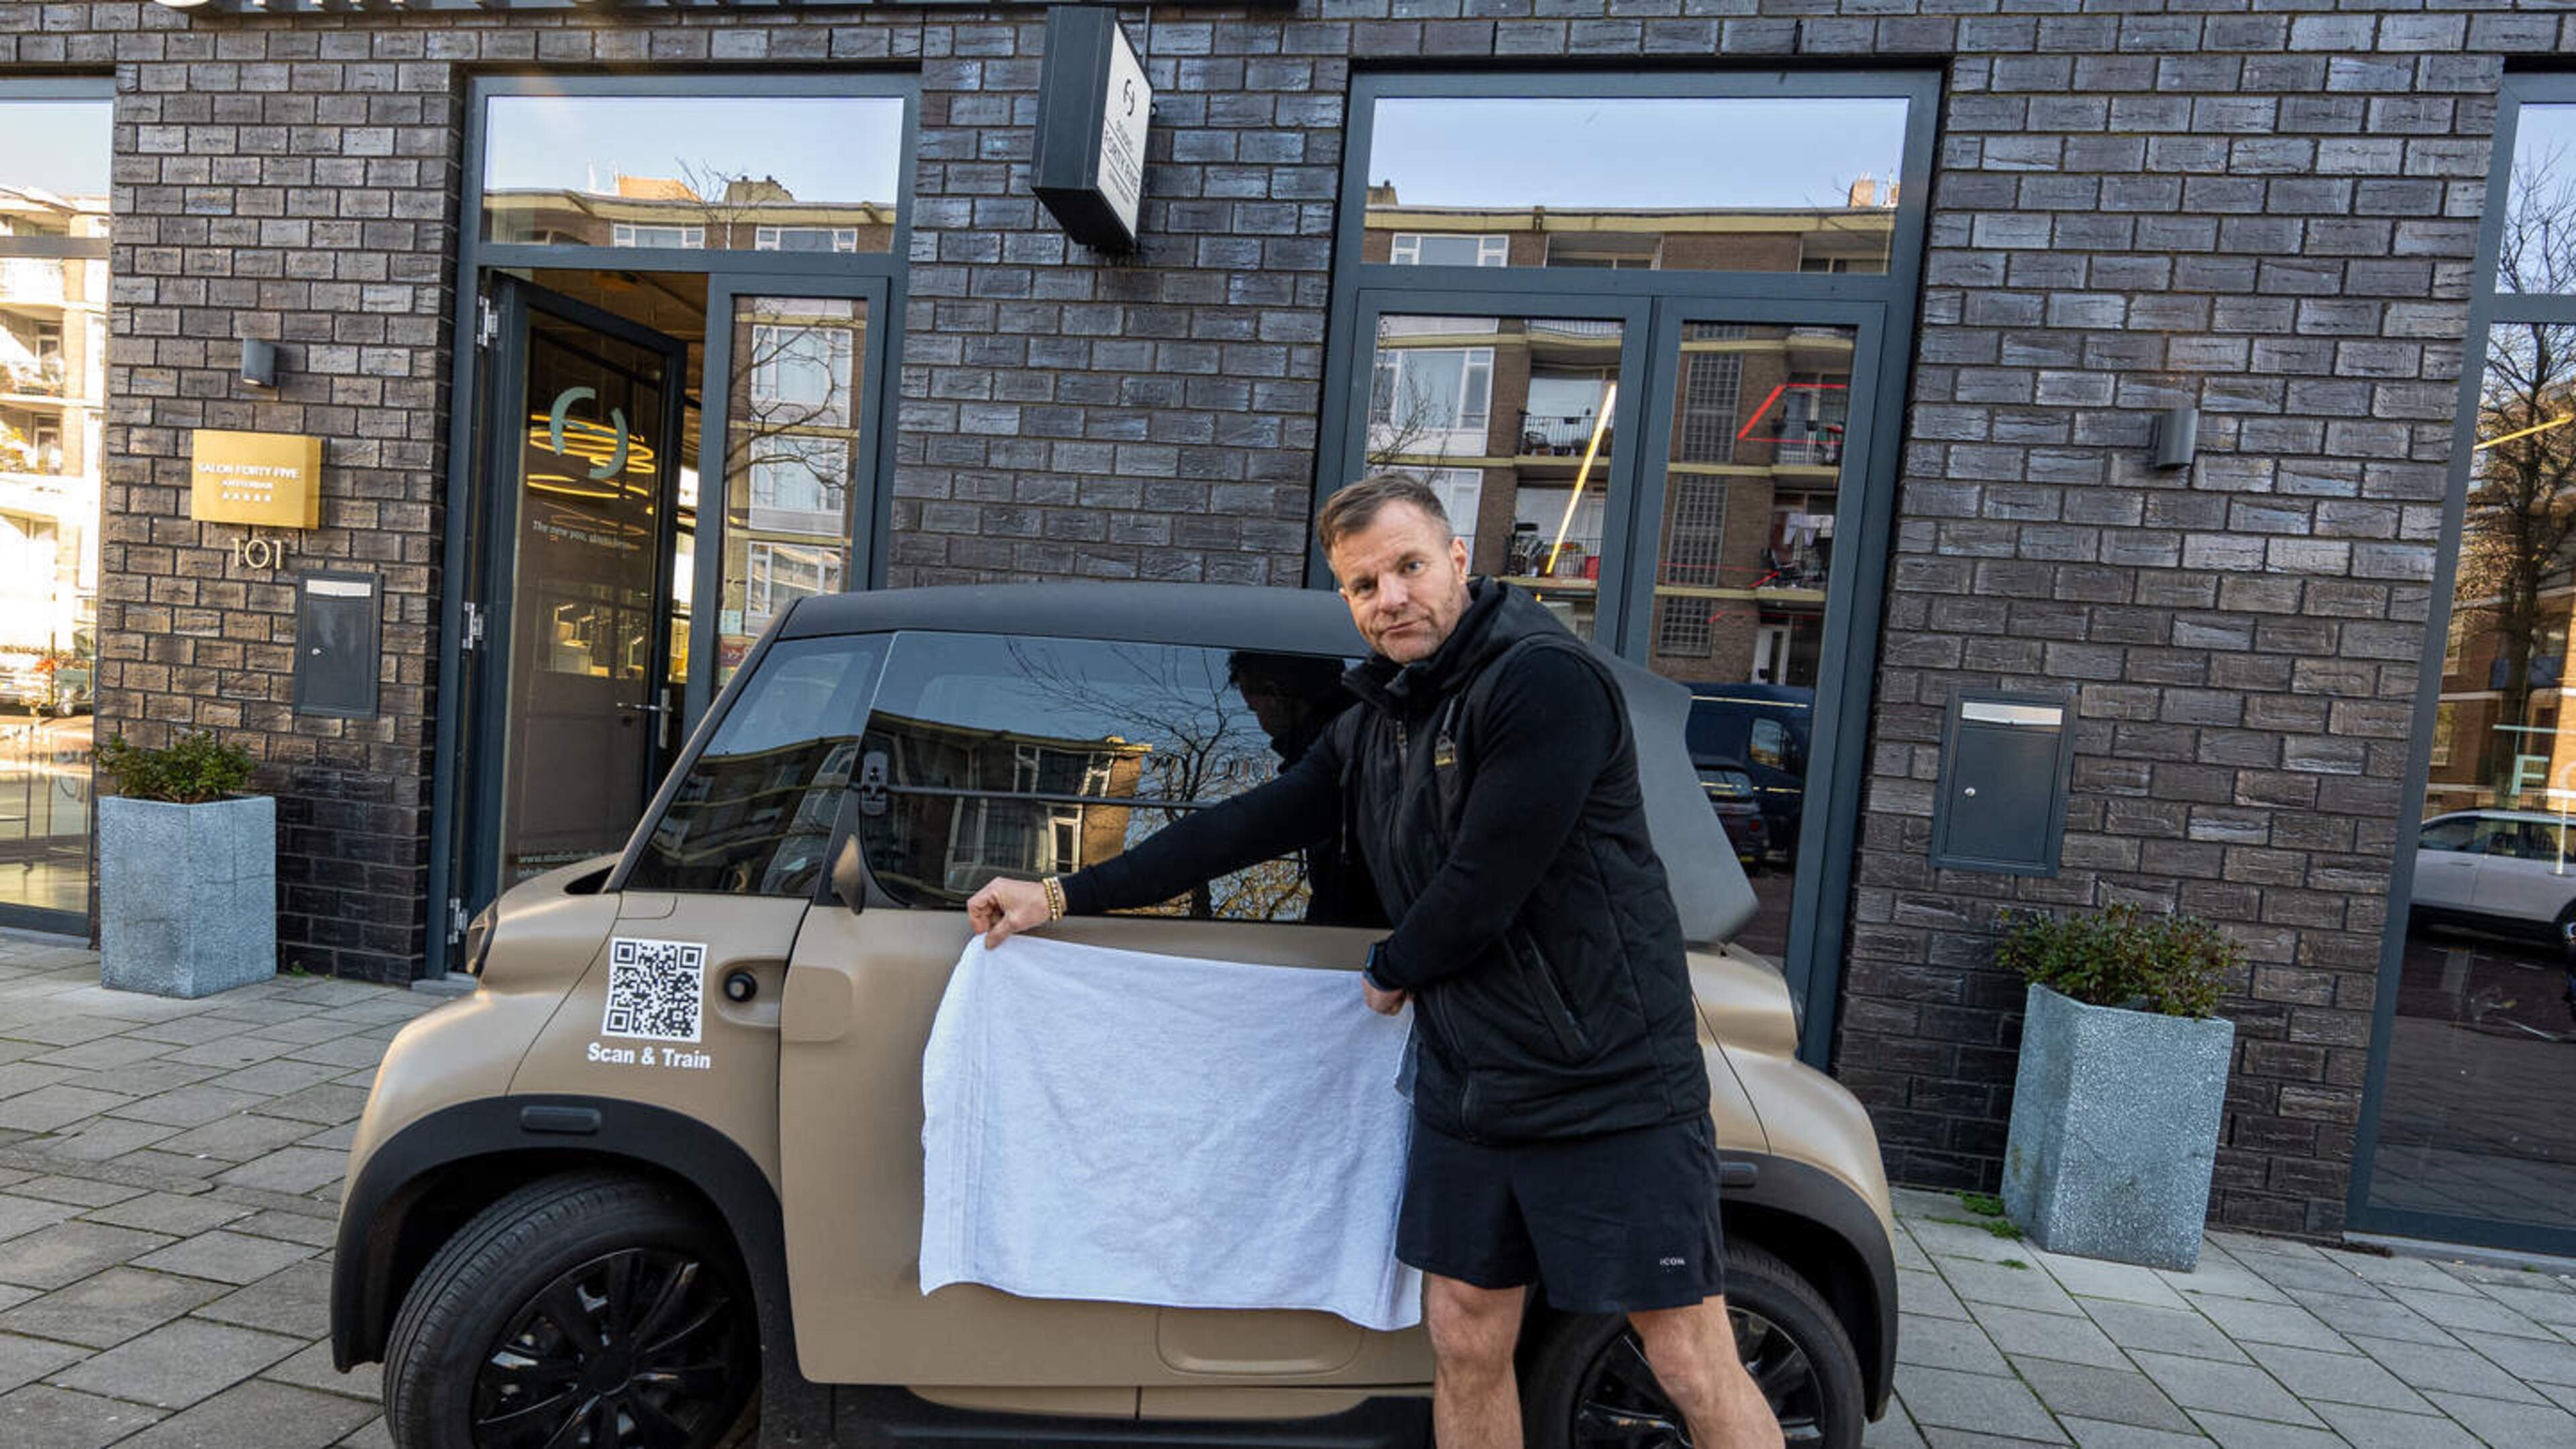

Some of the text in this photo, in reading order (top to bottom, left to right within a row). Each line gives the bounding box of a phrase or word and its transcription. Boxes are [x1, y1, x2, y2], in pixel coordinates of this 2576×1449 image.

[1104, 129, 1125, 169] FORTY
[199, 464, 302, 479] SALON FORTY FIVE
[230, 537, 282, 570] 101
[587, 1042, 711, 1069] Scan & Train
